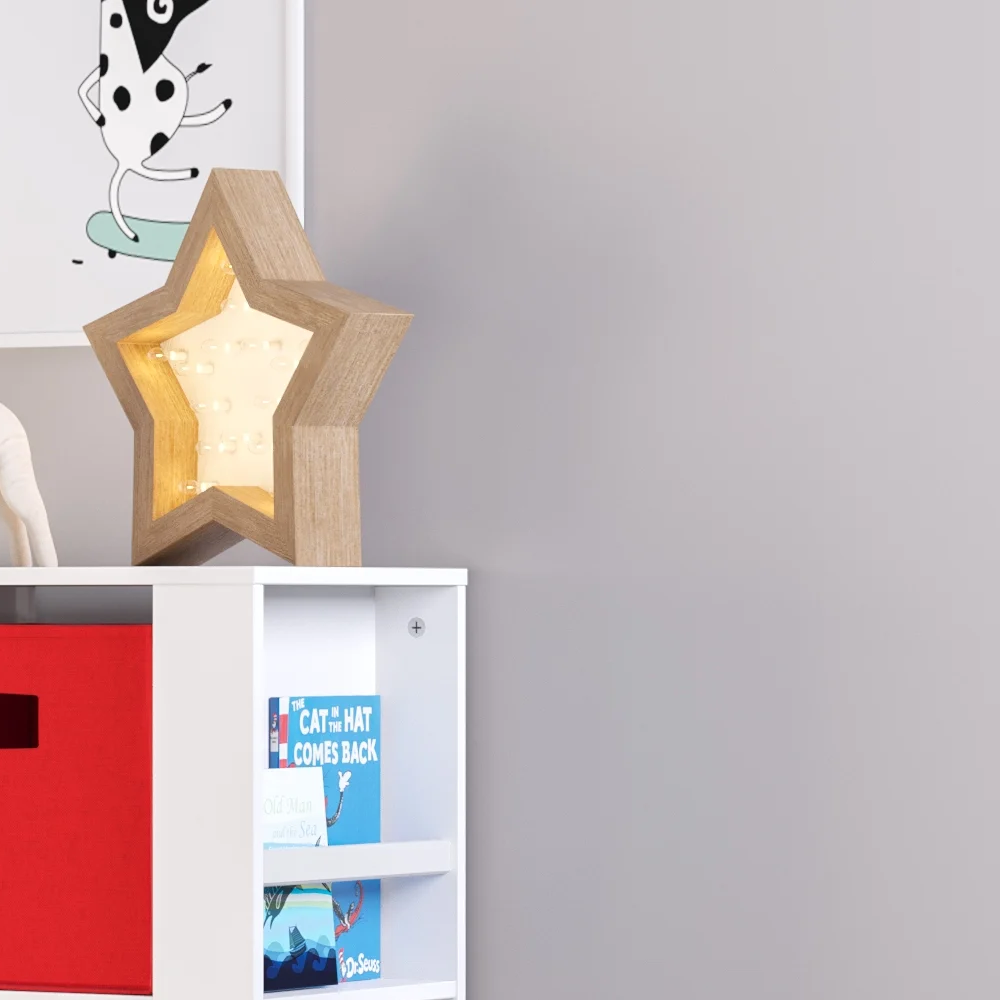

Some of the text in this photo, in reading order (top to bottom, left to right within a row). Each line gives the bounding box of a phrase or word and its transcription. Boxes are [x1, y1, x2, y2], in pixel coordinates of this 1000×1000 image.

[291, 698, 305, 712] THE
[299, 706, 372, 735] CAT IN THE HAT
[293, 738, 378, 766] COMES BACK
[264, 795, 312, 815] Old Man
[298, 820, 317, 838] Sea
